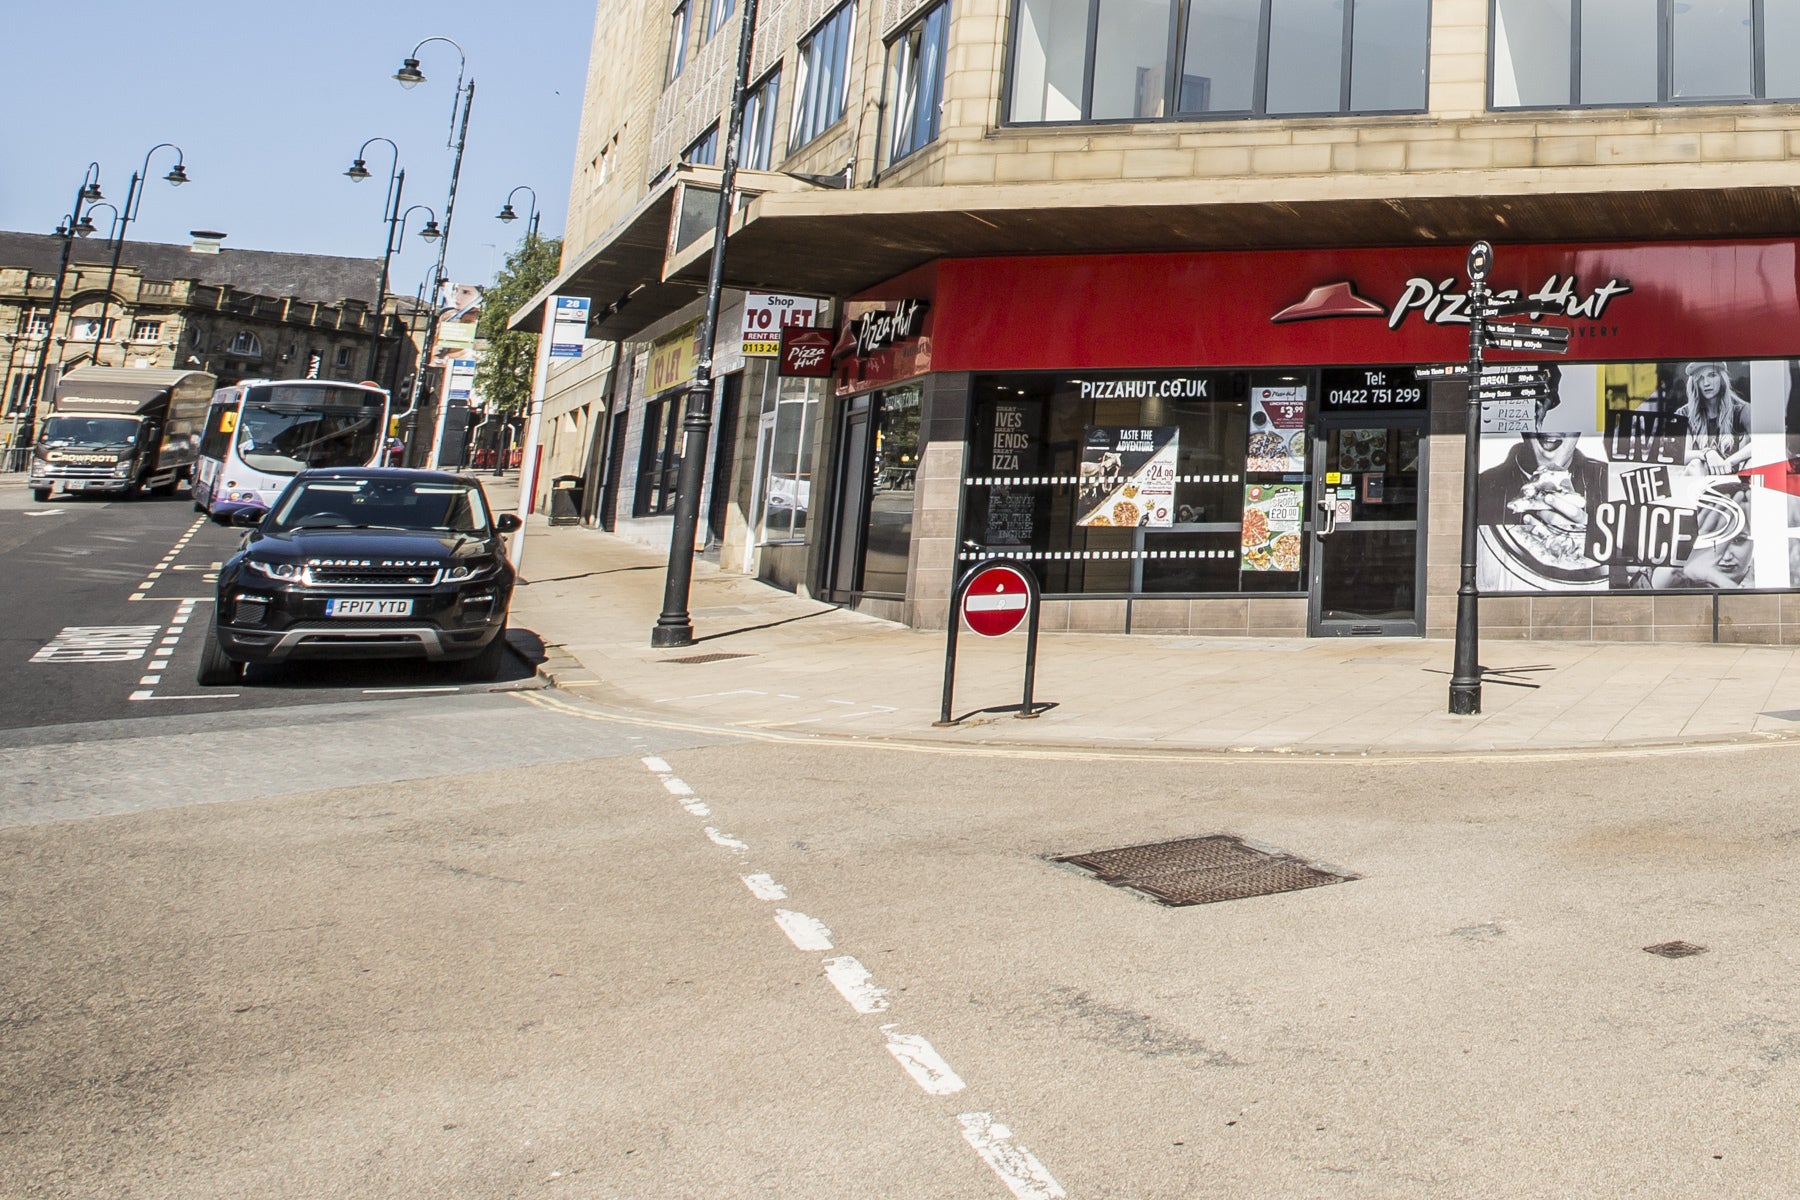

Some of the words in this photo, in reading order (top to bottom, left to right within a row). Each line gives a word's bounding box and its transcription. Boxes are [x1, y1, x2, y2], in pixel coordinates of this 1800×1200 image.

[566, 300, 580, 308] 28
[768, 296, 795, 309] Shop
[1529, 274, 1631, 322] Hut
[747, 308, 773, 329] TO
[779, 309, 813, 328] LET
[857, 310, 891, 357] Pizza
[890, 299, 919, 342] Hut
[742, 343, 765, 353] 0113
[787, 346, 826, 361] Pizza
[653, 355, 665, 390] TO
[665, 346, 682, 385] LET
[793, 356, 823, 371] Hut
[1364, 371, 1387, 386] Tel:
[1480, 374, 1508, 385] EUREKA!
[1080, 379, 1208, 399] PIZZAHUT.CO.UK
[1329, 389, 1368, 404] 01422
[1371, 389, 1393, 404] 751
[1395, 388, 1421, 403] 299
[1280, 405, 1304, 419] £3.99
[1498, 408, 1530, 418] PIZZA
[1497, 421, 1530, 431] PIZZA
[1120, 429, 1139, 440] TASTE
[1140, 429, 1153, 441] THE
[1612, 413, 1678, 463] LIVE
[1115, 441, 1154, 452] ADVENTURE
[47, 452, 119, 463] CROWFOOTS
[1622, 467, 1668, 505] THE
[1592, 502, 1695, 568] SLICE
[339, 601, 375, 613] FP17
[379, 601, 408, 613] YTD
